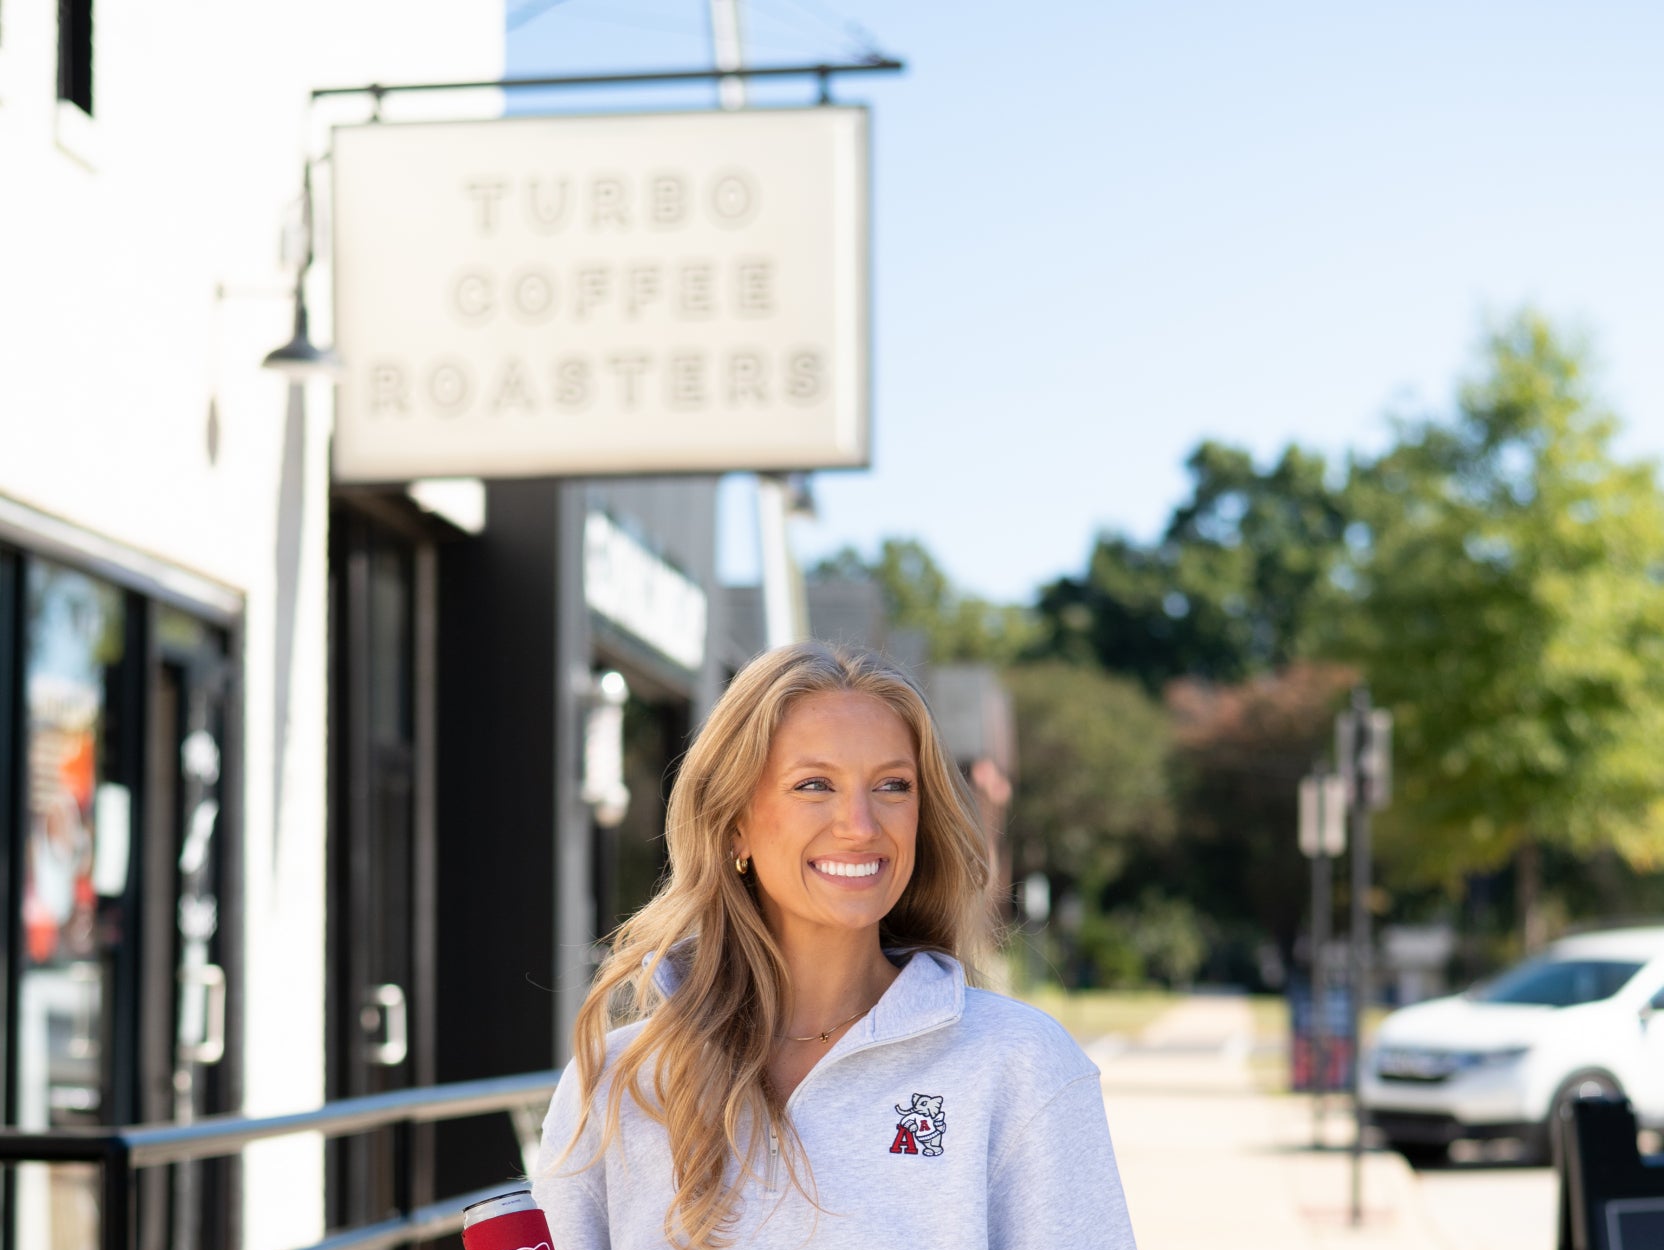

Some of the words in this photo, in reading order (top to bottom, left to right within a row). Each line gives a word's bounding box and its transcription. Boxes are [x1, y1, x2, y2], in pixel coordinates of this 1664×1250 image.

[463, 169, 758, 233] TURBO
[451, 258, 778, 321] COFFEE
[367, 348, 828, 414] ROASTERS
[890, 1124, 918, 1154] A
[920, 1119, 931, 1131] A
